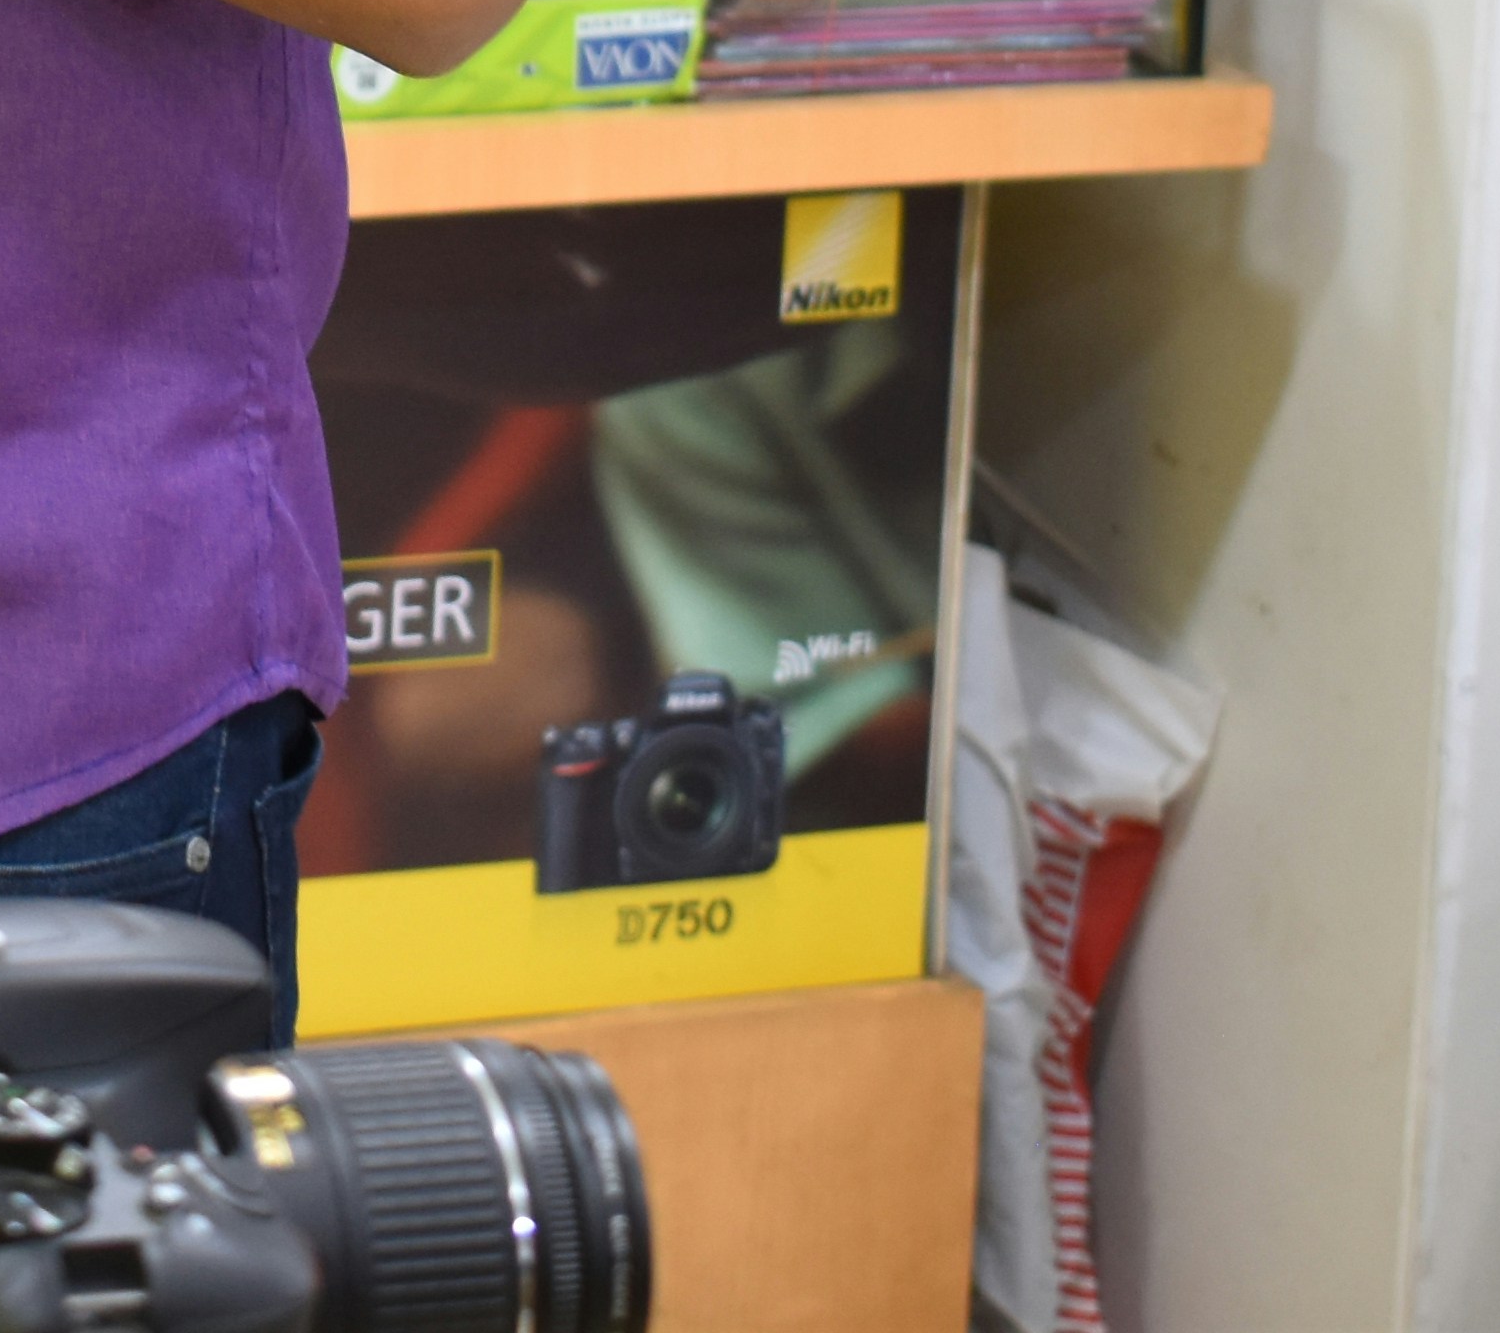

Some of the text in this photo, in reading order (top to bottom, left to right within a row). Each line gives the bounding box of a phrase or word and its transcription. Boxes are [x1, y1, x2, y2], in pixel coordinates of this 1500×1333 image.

[580, 33, 690, 87] NOVA
[787, 282, 890, 314] Nikon
[807, 632, 878, 662] Wi-Fi
[665, 690, 723, 711] Nikon
[616, 899, 734, 945] D750
